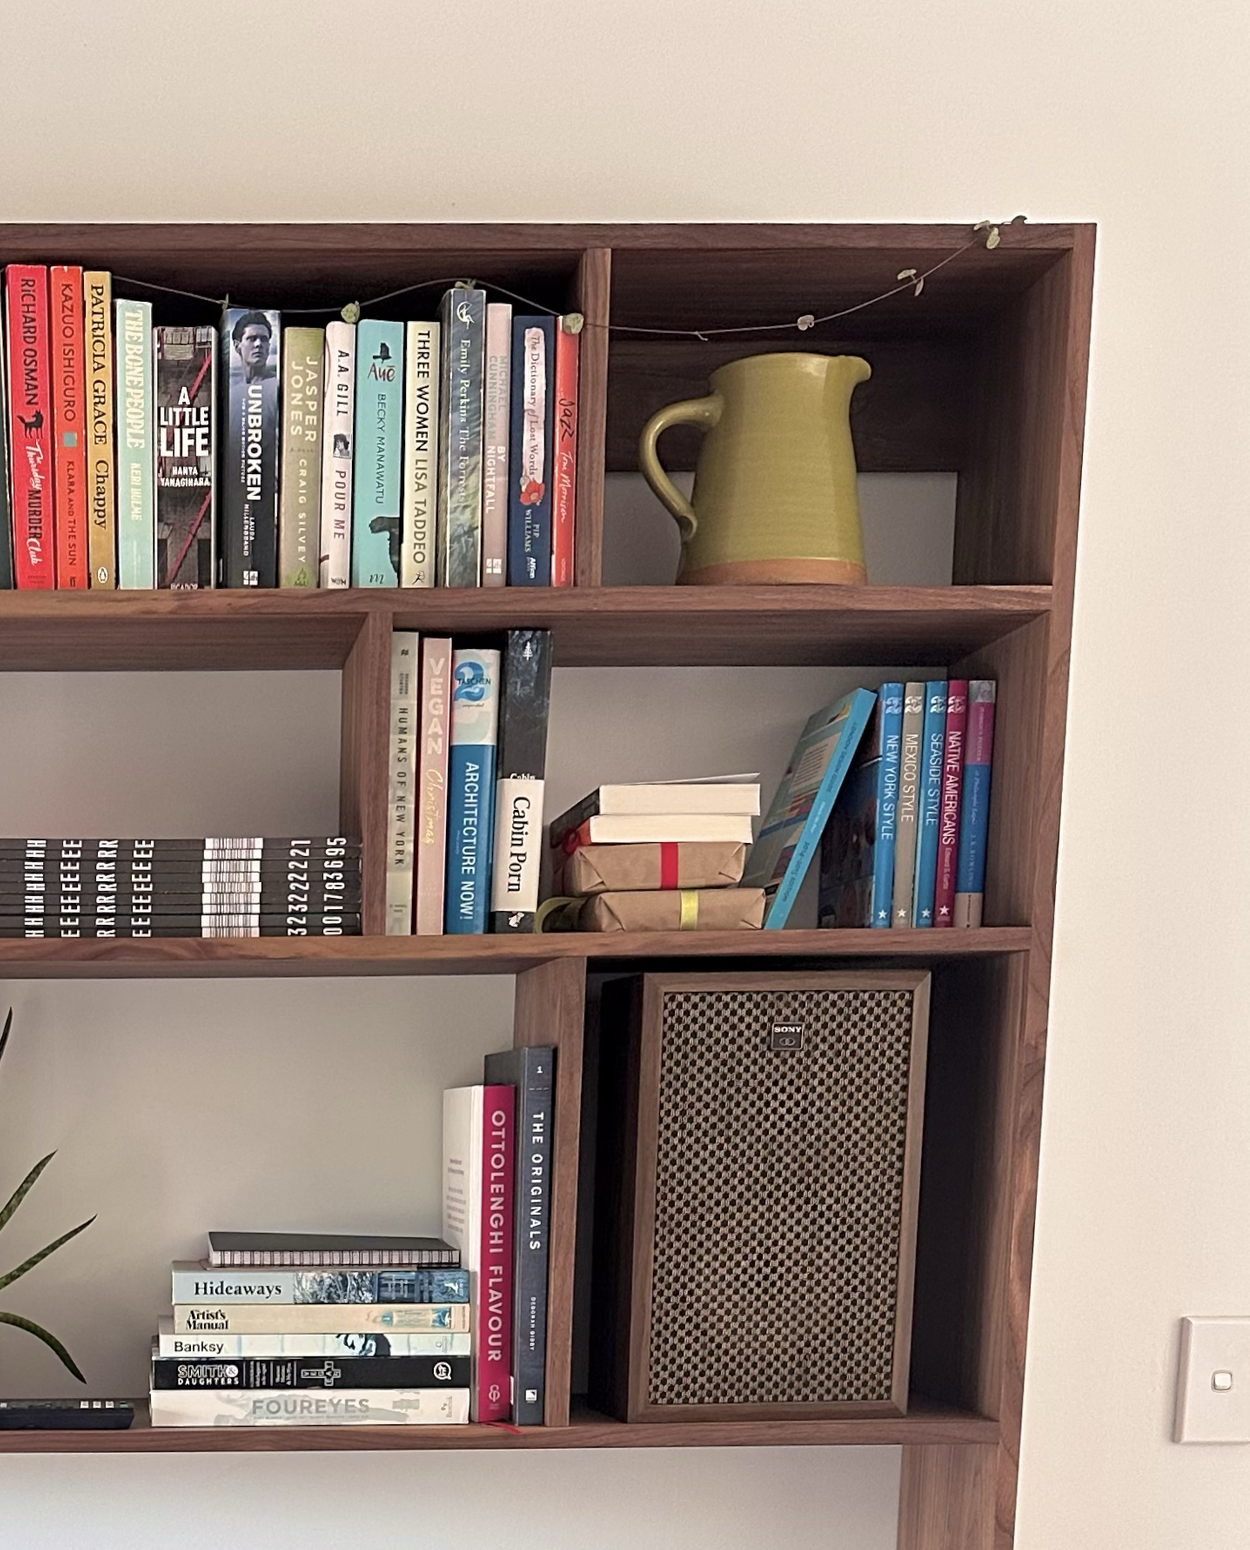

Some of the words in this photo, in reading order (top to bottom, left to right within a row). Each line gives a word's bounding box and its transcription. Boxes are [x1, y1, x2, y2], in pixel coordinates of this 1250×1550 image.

[61, 283, 74, 339] KAZUO
[90, 284, 106, 374] PATRICIA
[124, 309, 143, 342] THE
[124, 344, 144, 388] BONE
[416, 330, 431, 379] THREE
[62, 343, 77, 423] ISHIGURO
[177, 387, 191, 405] A
[290, 361, 304, 436] JONES
[305, 356, 319, 442] JASPER
[92, 378, 107, 445] GRACE
[125, 389, 145, 449] PEOPLE
[159, 406, 209, 426] LITTLE
[377, 393, 388, 432] BECKY
[415, 384, 430, 452] WOMEN
[160, 427, 209, 457] LIFE
[246, 384, 263, 501] UNBROKEN
[497, 445, 506, 462] BY
[66, 461, 75, 495] KLARA
[172, 466, 198, 476] HANYA
[298, 458, 308, 504] CRAIG
[333, 469, 347, 511] POUR
[375, 436, 387, 505] MANAWATU
[414, 458, 428, 492] LISA
[486, 445, 497, 514] NIGHTFALL
[67, 498, 75, 517] AND
[93, 459, 110, 531] Chappy
[68, 518, 77, 539] THE
[297, 512, 307, 563] SILVEY
[333, 519, 345, 541] ME
[412, 498, 428, 564] TADDEO
[68, 543, 77, 566] SUN
[397, 707, 409, 763] HUMANS
[885, 735, 899, 763] NEW
[946, 731, 961, 772] NATIVE
[903, 733, 918, 781] MEXICO
[928, 733, 944, 785] SEASIDE
[396, 772, 407, 786] OF
[883, 766, 898, 800] YORK
[395, 795, 406, 823] NEW
[460, 762, 480, 875] ARCHITECTURE
[510, 796, 531, 848] Cabin
[881, 802, 896, 841] STYLE
[900, 784, 916, 822] STYLE
[925, 789, 941, 826] STYLE
[942, 774, 959, 846] AMERICANS
[394, 831, 406, 865] YORK
[507, 851, 528, 893] Porn
[459, 880, 475, 920] NOW!
[532, 1112, 544, 1145] THE
[489, 1109, 507, 1254] OTTOLENGHI
[529, 1153, 544, 1250] ORIGINALS
[193, 1280, 283, 1300] Hideaways
[185, 1318, 229, 1331] Manual
[187, 1309, 227, 1321] Artist's
[487, 1266, 503, 1362] FLAVOUR
[174, 1341, 225, 1355] Banksy
[177, 1378, 239, 1386] DAUGHTERS
[252, 1398, 370, 1415] FOUREYES
